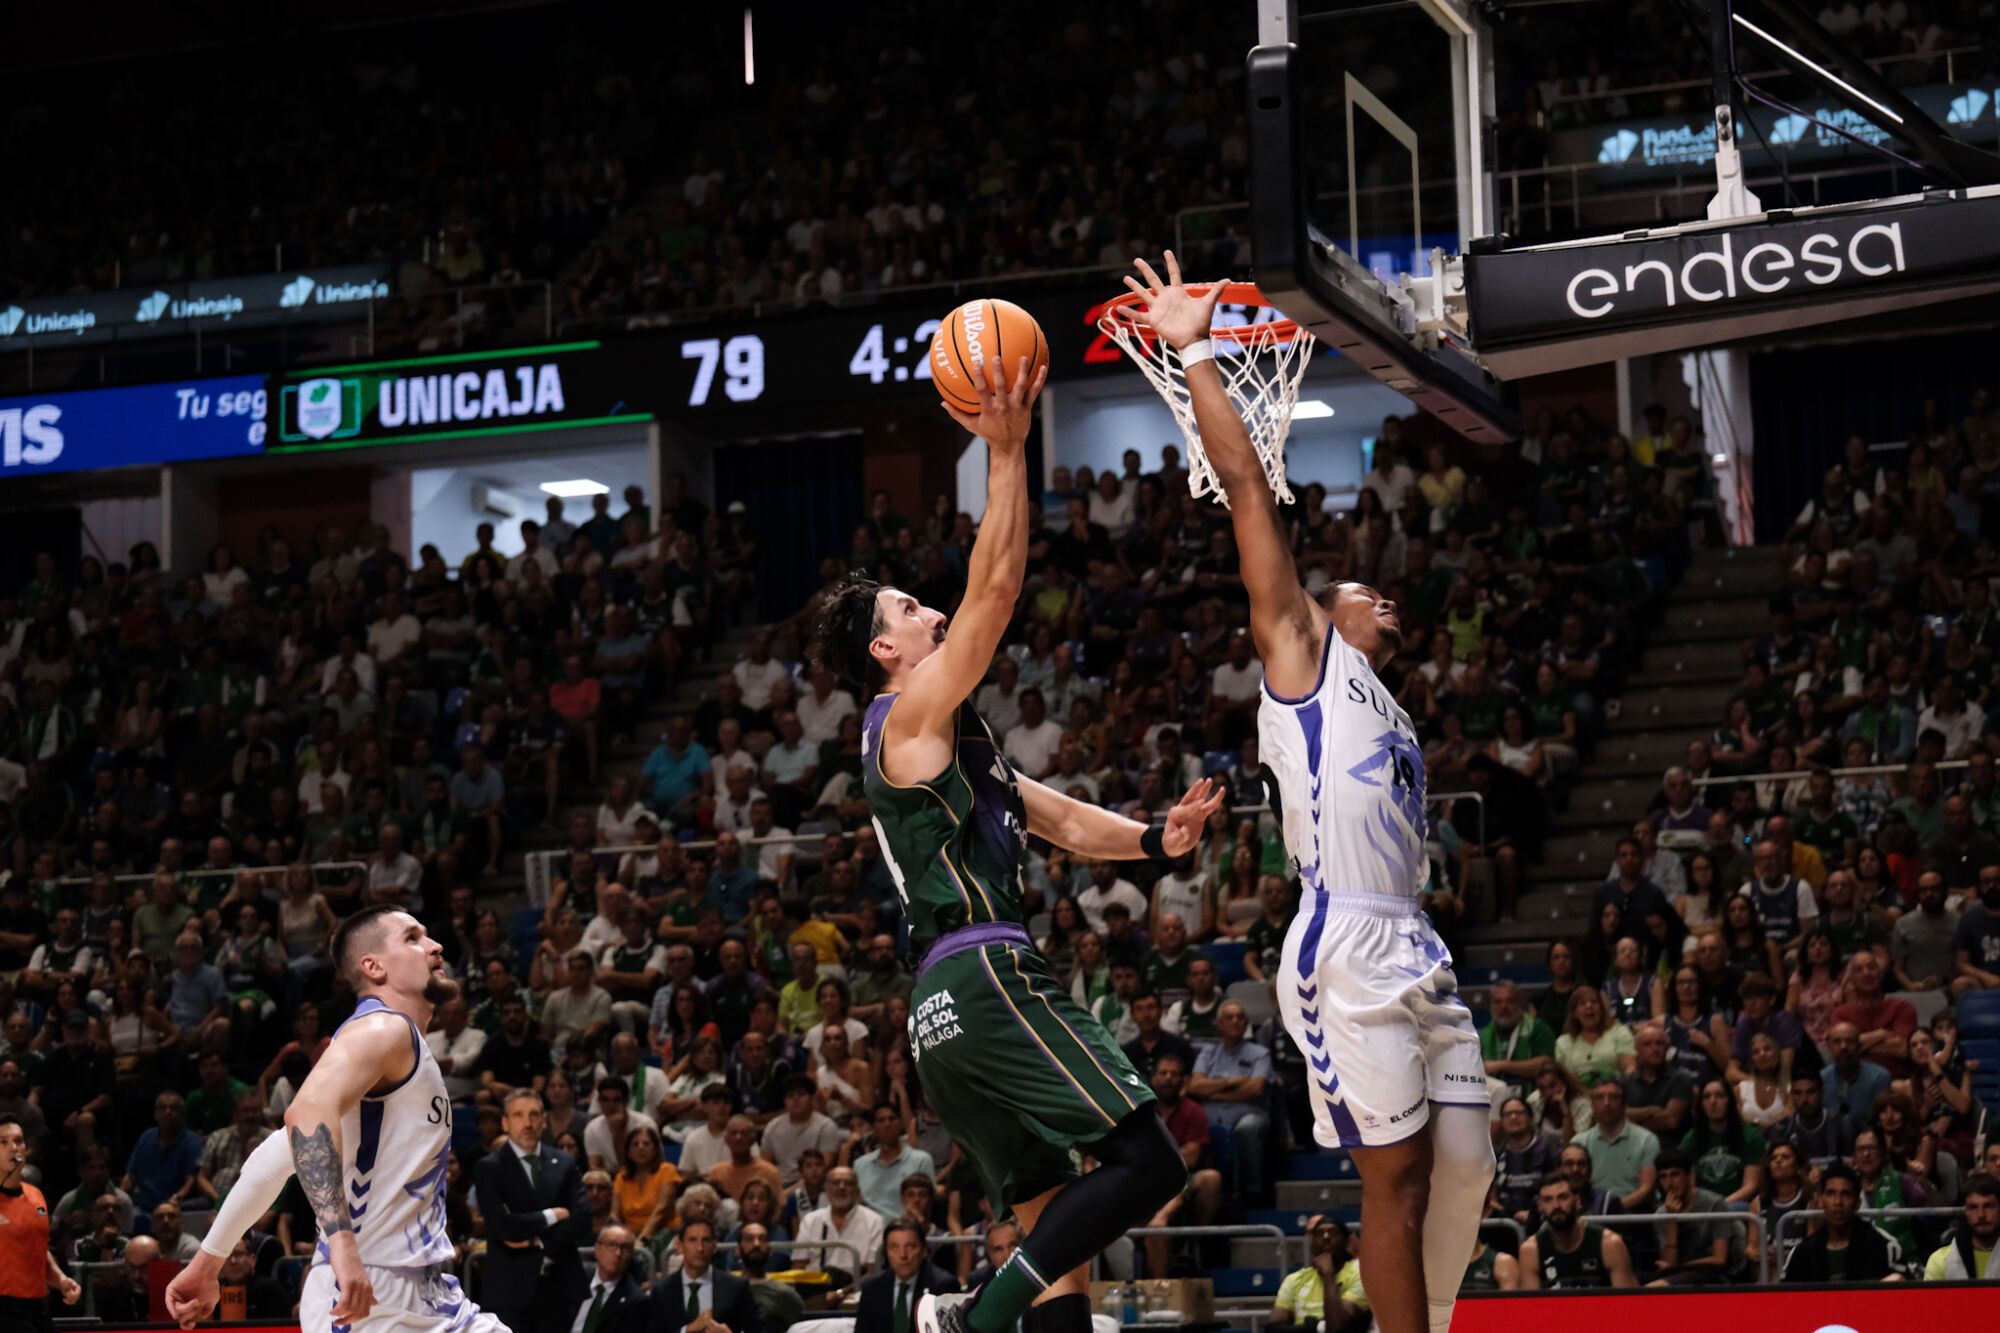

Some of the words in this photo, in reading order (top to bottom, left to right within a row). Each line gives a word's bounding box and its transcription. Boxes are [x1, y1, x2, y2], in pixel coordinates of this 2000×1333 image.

[1566, 222, 1906, 318] endesa
[26, 308, 96, 336] Unicaja
[963, 302, 986, 368] Wilson
[682, 335, 765, 406] 79
[177, 388, 210, 420] Tu
[216, 389, 268, 420] seg
[379, 363, 565, 427] UNICAJA
[248, 420, 267, 446] e
[917, 989, 955, 1020] COSTA
[918, 1019, 934, 1038] DEL
[931, 1008, 959, 1028] SOL
[1390, 1115, 1402, 1123] EL
